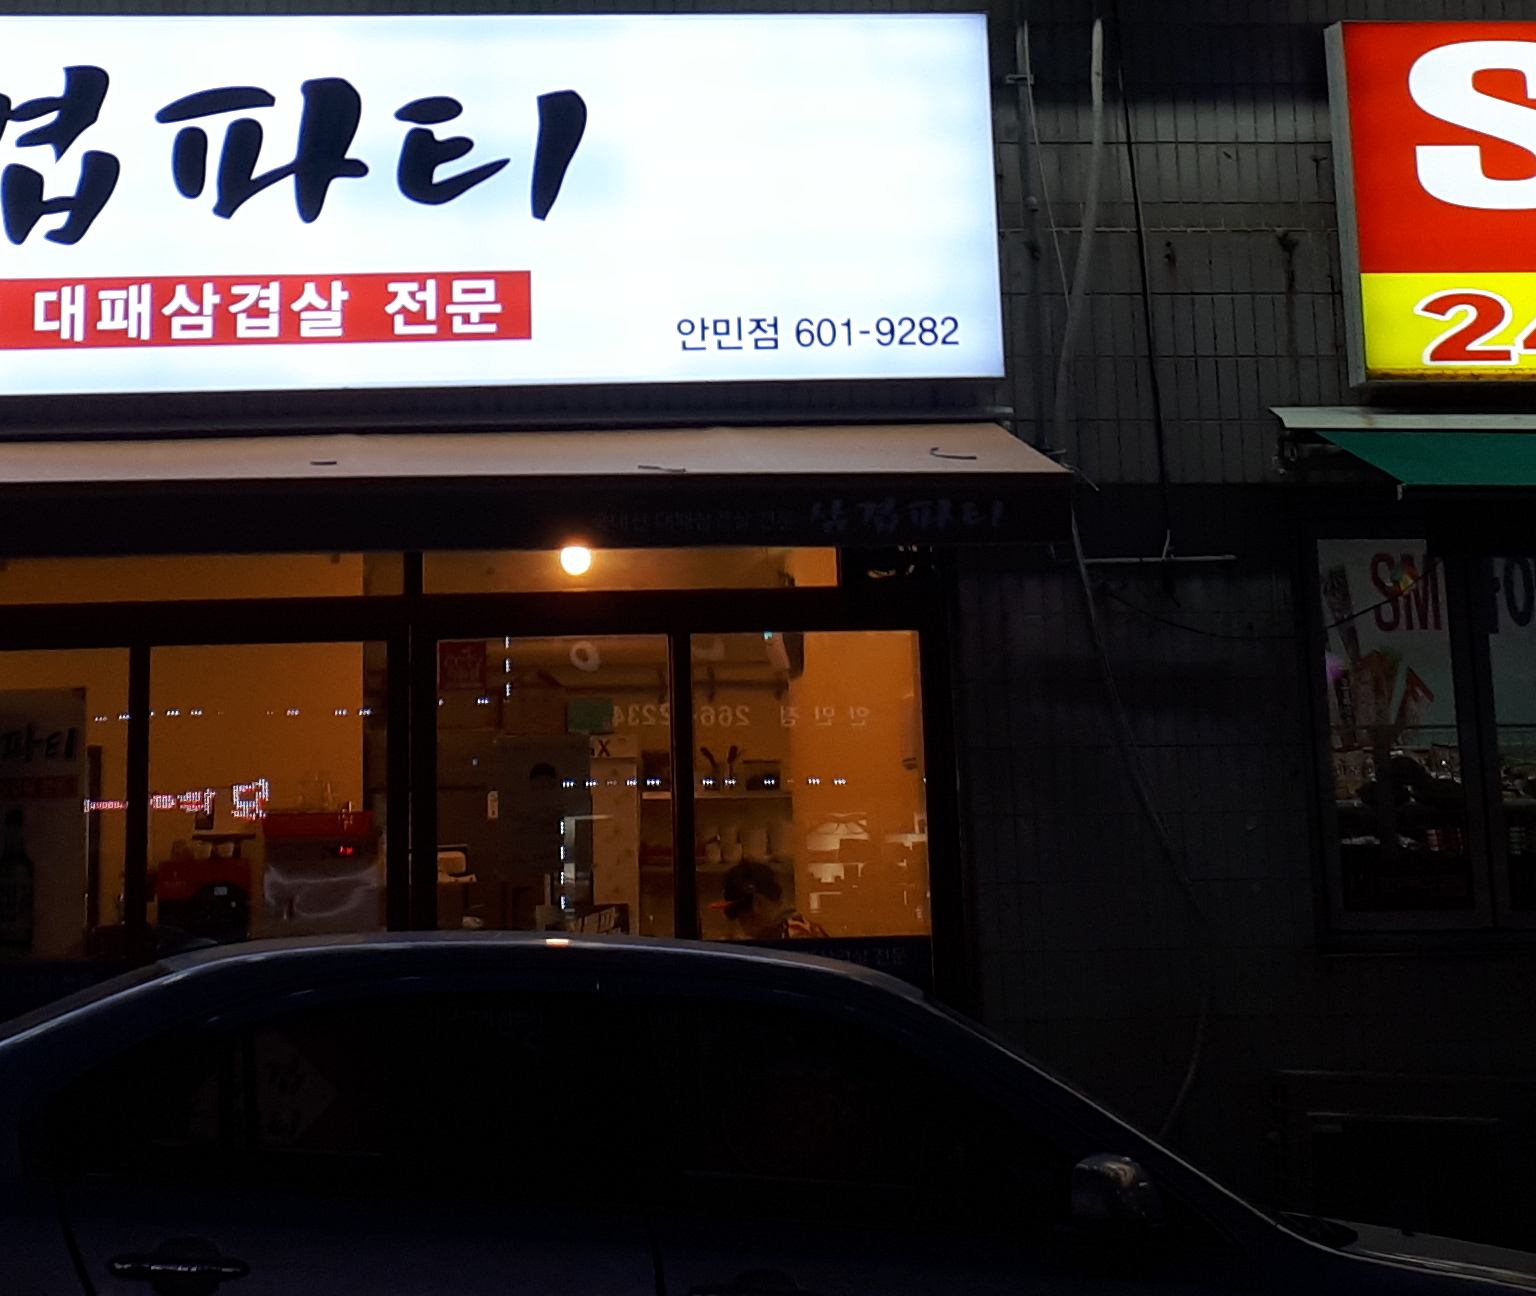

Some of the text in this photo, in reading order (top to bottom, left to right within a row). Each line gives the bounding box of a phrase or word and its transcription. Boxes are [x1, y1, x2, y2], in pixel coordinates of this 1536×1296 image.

[32, 280, 351, 344] 대패삼겹살
[384, 275, 504, 334] 전문
[677, 315, 960, 351] 안민점 601-9282
